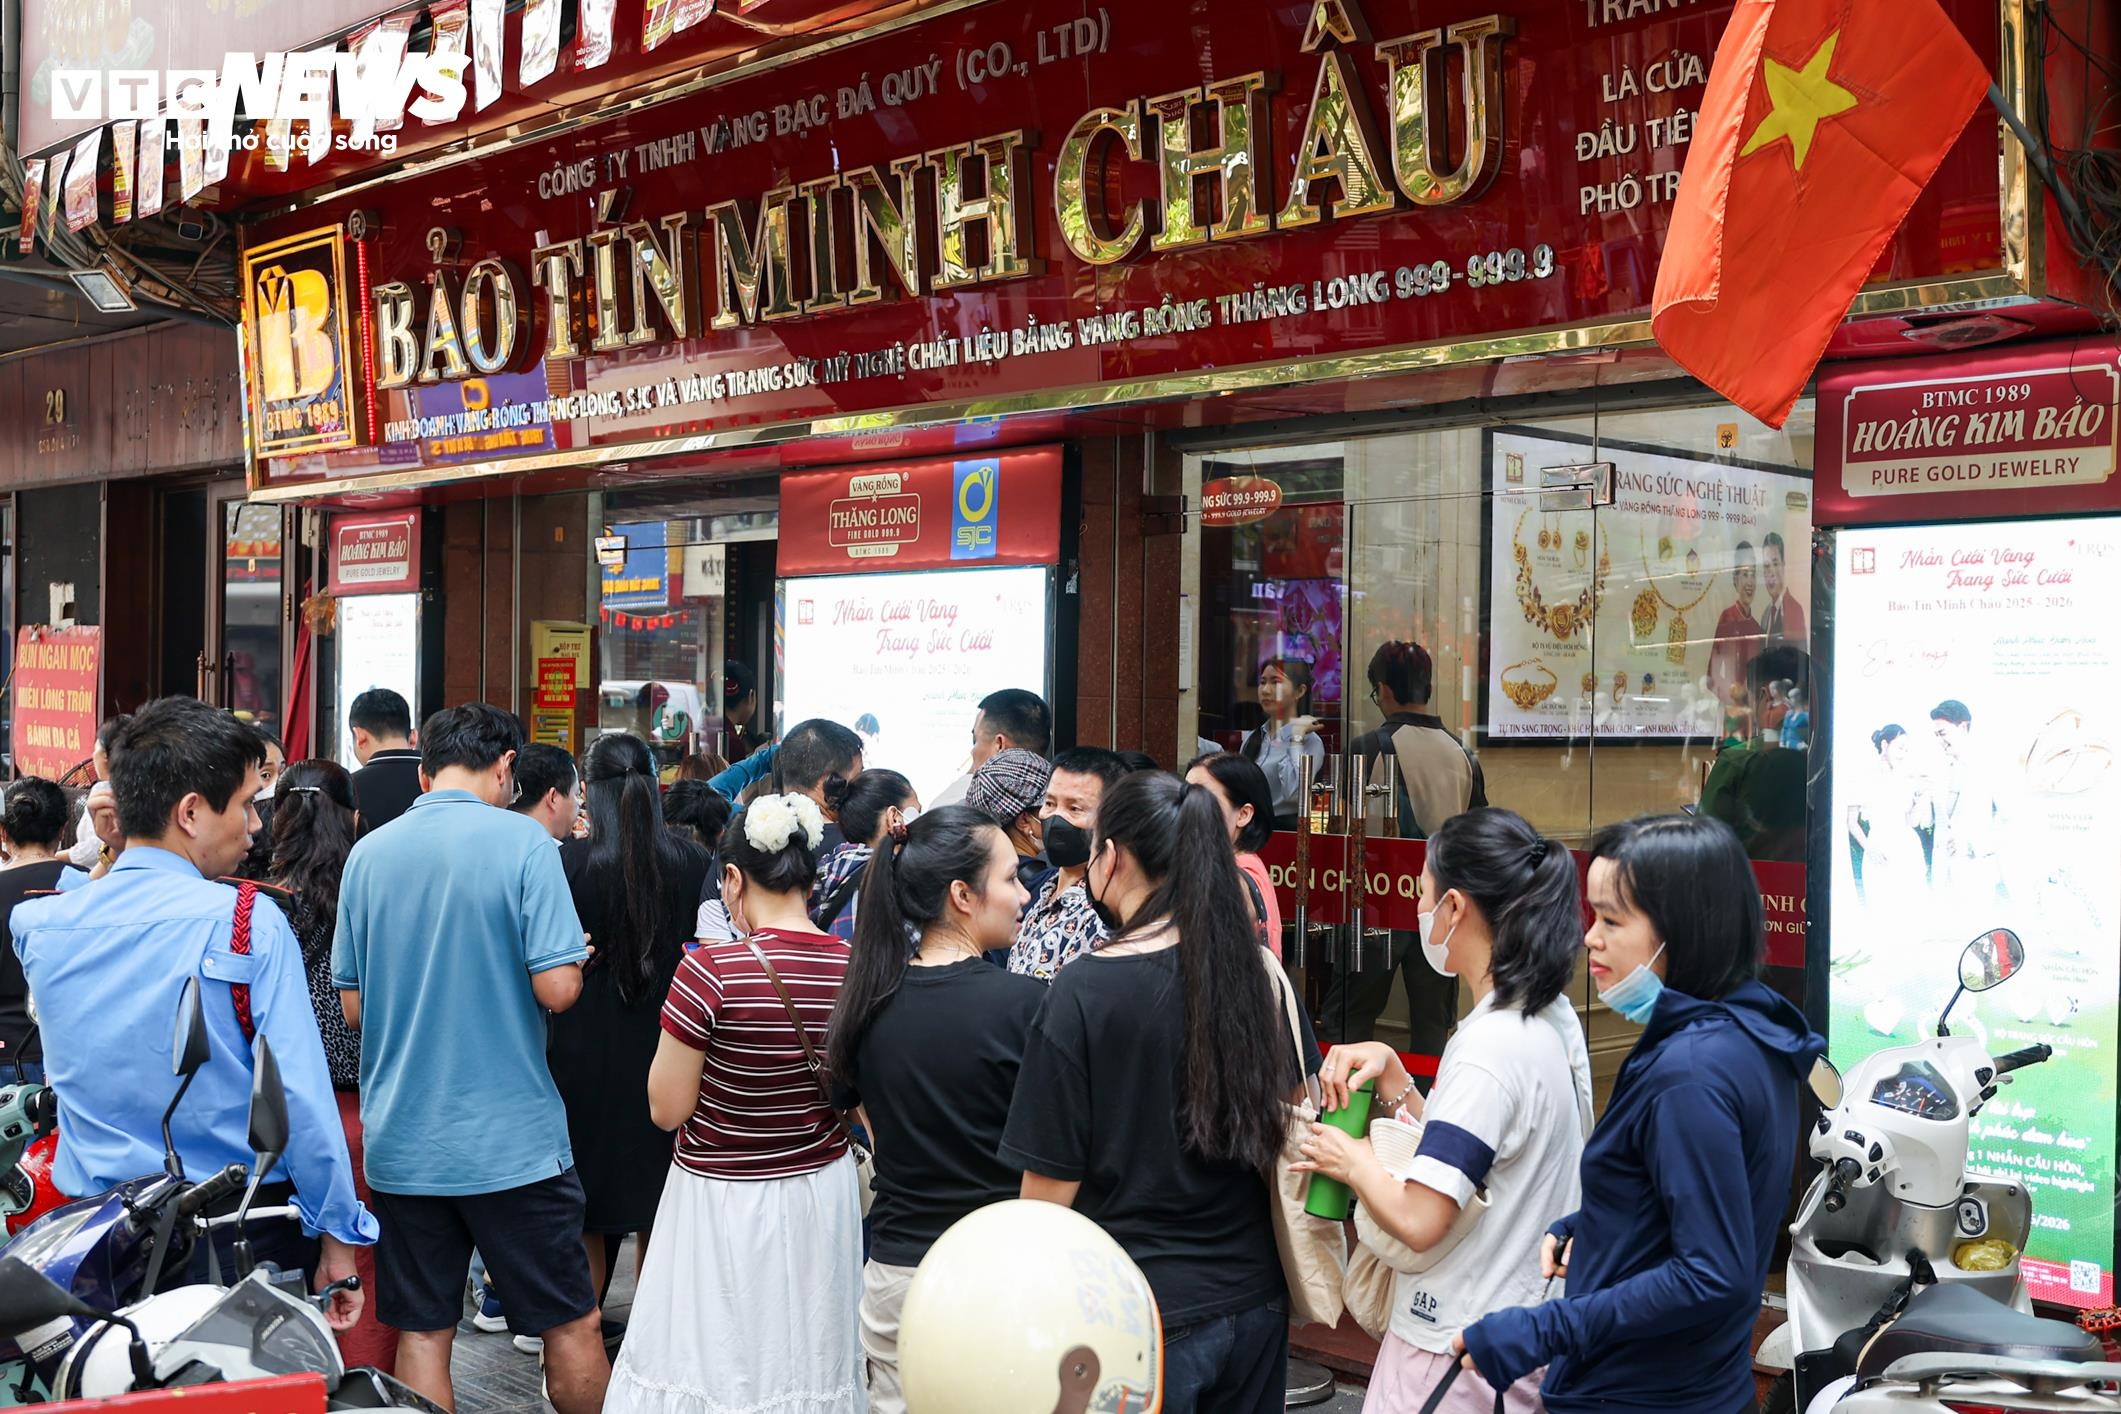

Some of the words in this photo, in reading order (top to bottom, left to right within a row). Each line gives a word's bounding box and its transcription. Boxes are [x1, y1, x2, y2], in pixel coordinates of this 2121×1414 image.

[1603, 65, 1640, 103] LÀ
[1646, 49, 1706, 93] CỬA
[538, 157, 597, 200] CÔNG
[603, 150, 630, 183] TY
[635, 131, 696, 174] TNHH
[701, 111, 769, 155] VÀNG
[774, 94, 830, 138] BẠC
[836, 72, 876, 119] ĐÁ
[882, 53, 943, 106] QUÝ
[956, 41, 1029, 91] (CO.,
[1037, 8, 1111, 65] LTD)
[1576, 118, 1636, 162] ĐẦU
[372, 226, 518, 390] BẢO
[531, 189, 688, 359] TÍN
[705, 129, 1034, 330] MINH
[1054, 0, 1500, 265] CHÂU
[1580, 169, 1642, 215] PHỐ
[384, 418, 411, 442] KINH
[412, 413, 453, 440] DOANH
[455, 406, 489, 434] VÀNG
[491, 398, 530, 428] RỒNG
[531, 390, 578, 424] THĂNG
[579, 391, 625, 418] LONG,
[626, 388, 652, 412] SJC
[655, 376, 679, 407] VÀ
[681, 373, 725, 406] VÀNG
[726, 366, 783, 397] TRANG
[784, 355, 820, 389] SỨC
[822, 350, 850, 383] MỸ
[853, 340, 906, 381] NGHỆ
[909, 329, 960, 371] CHẤT
[964, 325, 1009, 367] LIỆU
[1012, 313, 1073, 356] BẰNG
[1077, 304, 1140, 346] VÀNG
[1143, 292, 1211, 337] RỒNG
[1216, 281, 1307, 326] THĂNG
[1314, 270, 1390, 311] LONG
[1395, 260, 1450, 299] 999
[1467, 243, 1554, 289] 999.9
[46, 388, 65, 424] 29
[1922, 389, 1979, 409] BTMC
[1985, 383, 2031, 405] 1989
[267, 407, 302, 433] BTMC
[307, 401, 339, 427] 1989
[1852, 408, 1959, 453] HOÀNG
[1963, 409, 2025, 445] KIM
[2032, 394, 2105, 440] BẢO
[852, 478, 874, 492] VÀNG
[876, 475, 899, 491] RỒNG
[1872, 469, 1920, 486] PURE
[1927, 464, 1982, 482] GOLD
[1988, 457, 2081, 480] JEWELRY
[1215, 491, 1232, 507] SỨC
[1656, 472, 1683, 497] SỨC
[1686, 479, 1722, 506] NGHỆ
[1726, 484, 1767, 511] THUẬT
[832, 505, 876, 528] THĂNG
[880, 506, 917, 525] LONG
[341, 540, 370, 561] HOÀNG
[370, 541, 387, 559] KIM
[388, 536, 407, 558] BẢO
[848, 530, 861, 540] FINE
[864, 529, 880, 539] GOLD
[957, 525, 991, 551] SJC
[39, 643, 68, 670] NGAN
[70, 645, 94, 675] MỌC
[41, 683, 64, 711] LÒNG
[67, 685, 92, 718] TRỘN
[27, 721, 50, 747] BÁNH
[67, 723, 80, 750] CÁ
[1521, 723, 1538, 734] SANG
[1414, 1291, 1437, 1312] GAP
